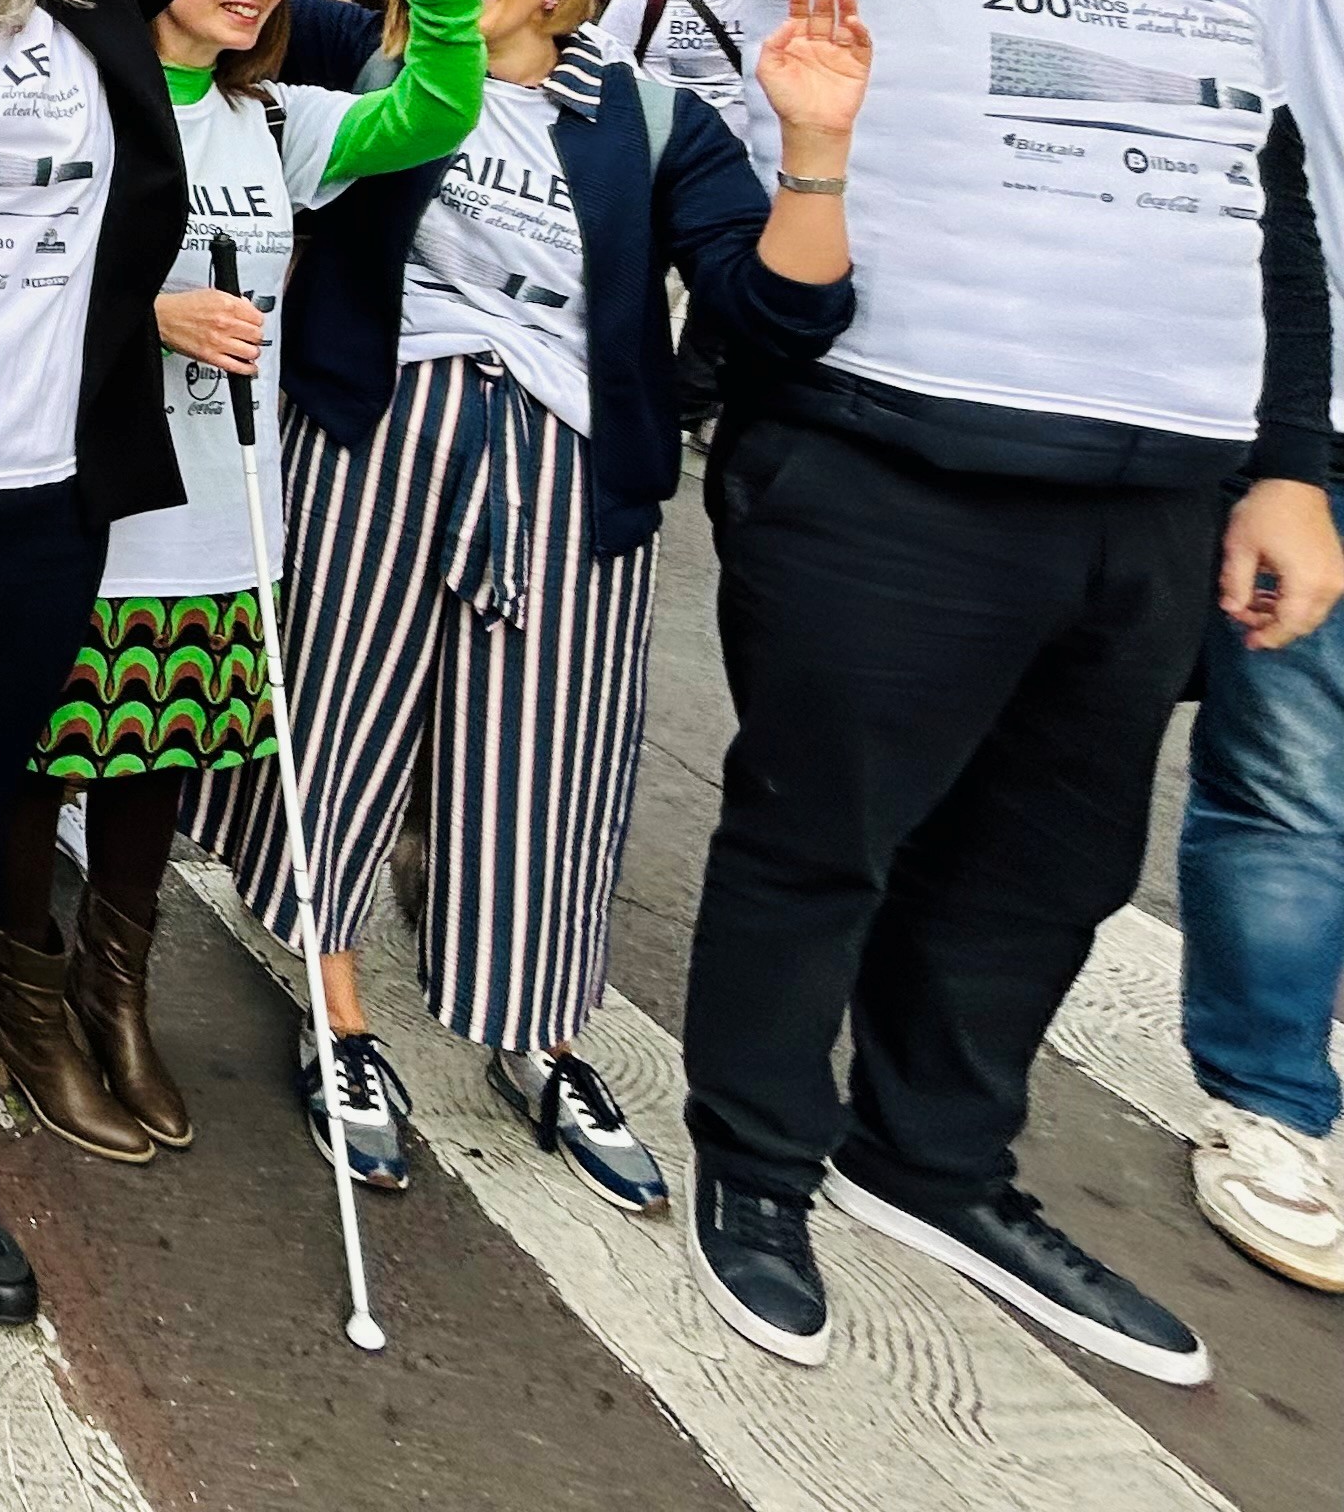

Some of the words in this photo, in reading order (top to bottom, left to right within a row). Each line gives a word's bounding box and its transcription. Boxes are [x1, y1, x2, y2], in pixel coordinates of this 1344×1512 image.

[667, 37, 703, 50] 200
[442, 181, 492, 207] AÑOS
[446, 152, 573, 213] AILLE
[439, 193, 483, 221] URTE
